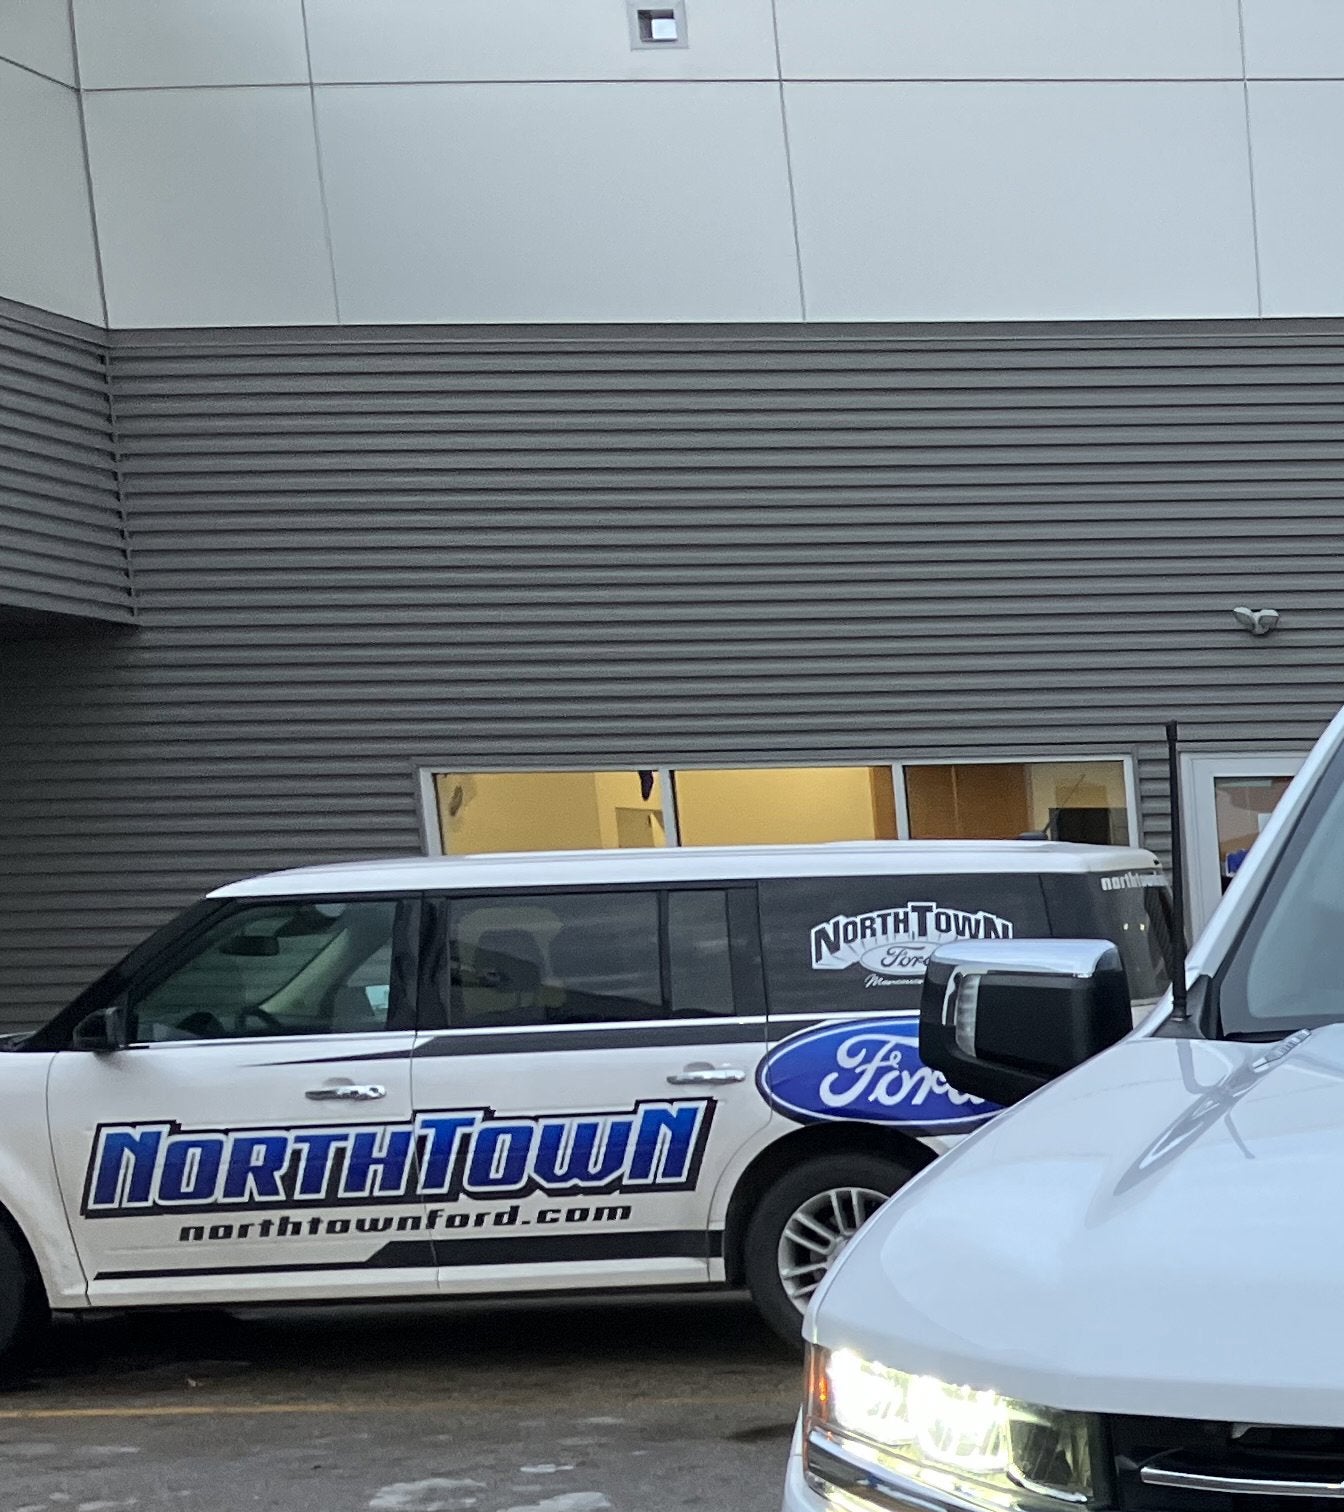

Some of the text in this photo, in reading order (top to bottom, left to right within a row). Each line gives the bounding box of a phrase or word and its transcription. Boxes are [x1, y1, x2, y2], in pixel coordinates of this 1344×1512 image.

[819, 1033, 985, 1107] For
[90, 1102, 706, 1208] NORTHTOWN
[179, 1203, 633, 1242] northtownford.com
